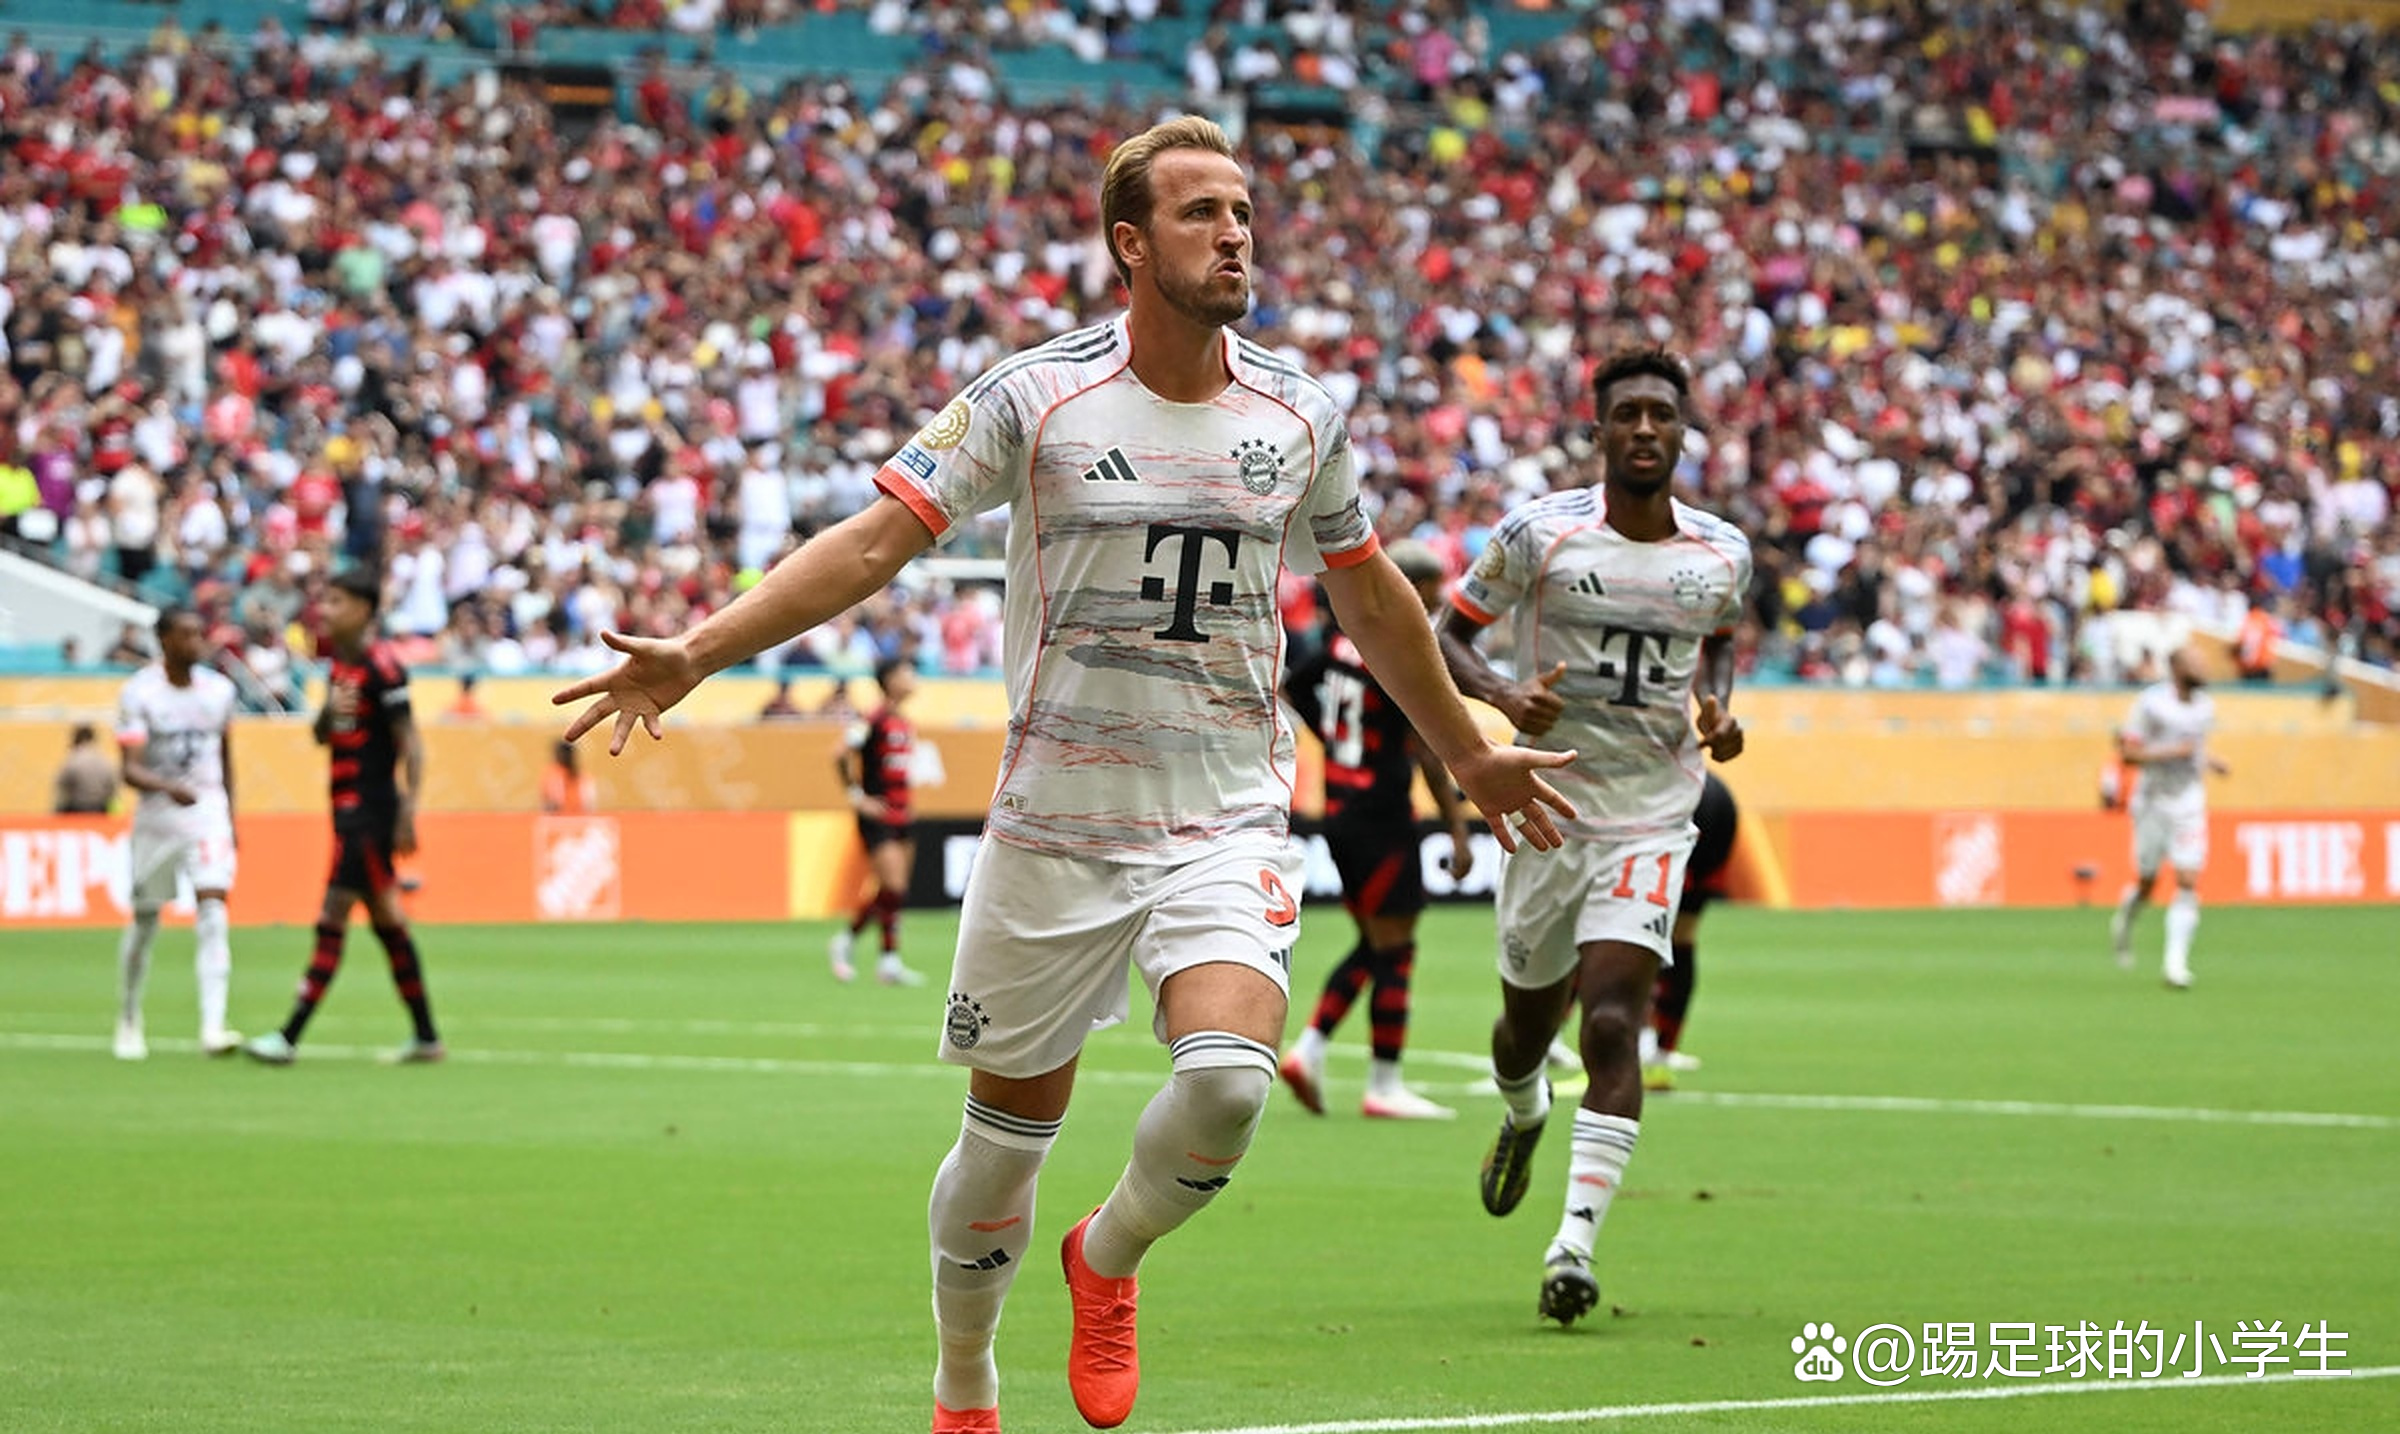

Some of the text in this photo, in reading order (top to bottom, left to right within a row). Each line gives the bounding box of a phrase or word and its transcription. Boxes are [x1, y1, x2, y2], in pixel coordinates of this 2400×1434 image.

[1141, 524, 1240, 643] T
[1599, 624, 1671, 708] T
[1612, 851, 1671, 909] 11
[2235, 820, 2365, 897] THE
[1259, 868, 1298, 929] 9
